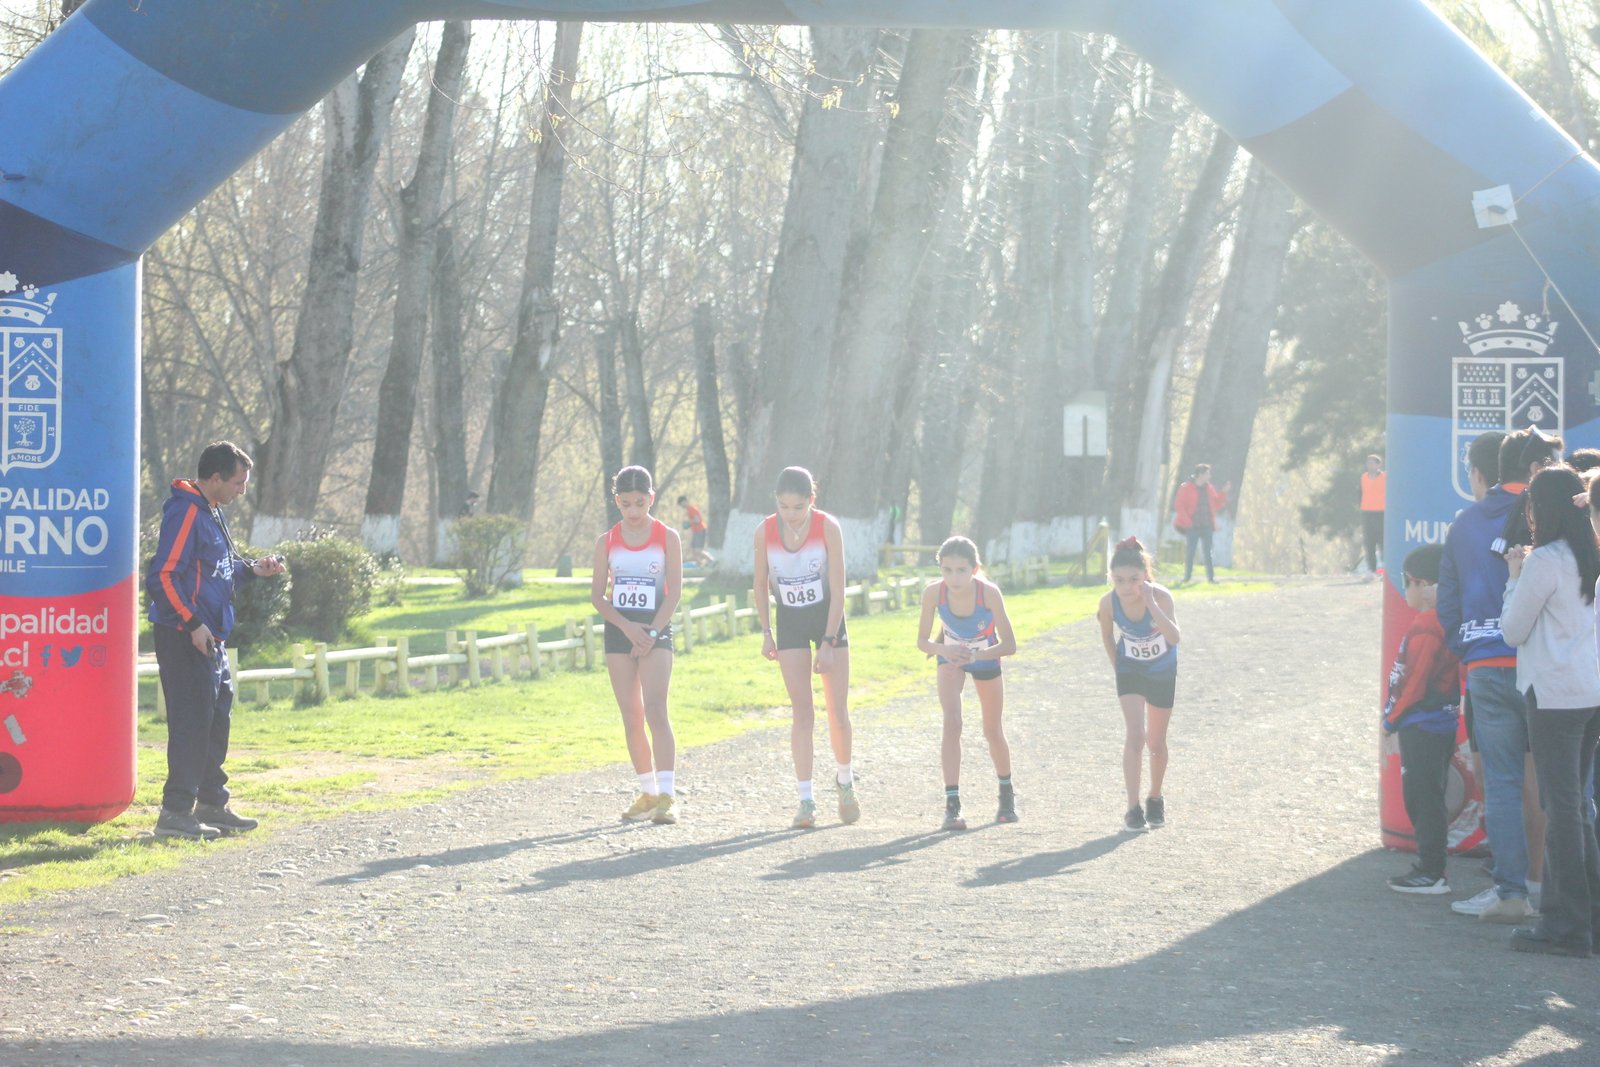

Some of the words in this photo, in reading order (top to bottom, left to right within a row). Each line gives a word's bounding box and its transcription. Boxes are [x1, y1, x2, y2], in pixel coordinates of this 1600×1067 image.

[48, 427, 54, 437] ET
[11, 455, 42, 463] AMORE
[0, 515, 109, 556] RNO
[618, 592, 647, 607] 049
[786, 588, 816, 604] 048
[0, 607, 108, 639] palidad
[1131, 643, 1160, 658] 050
